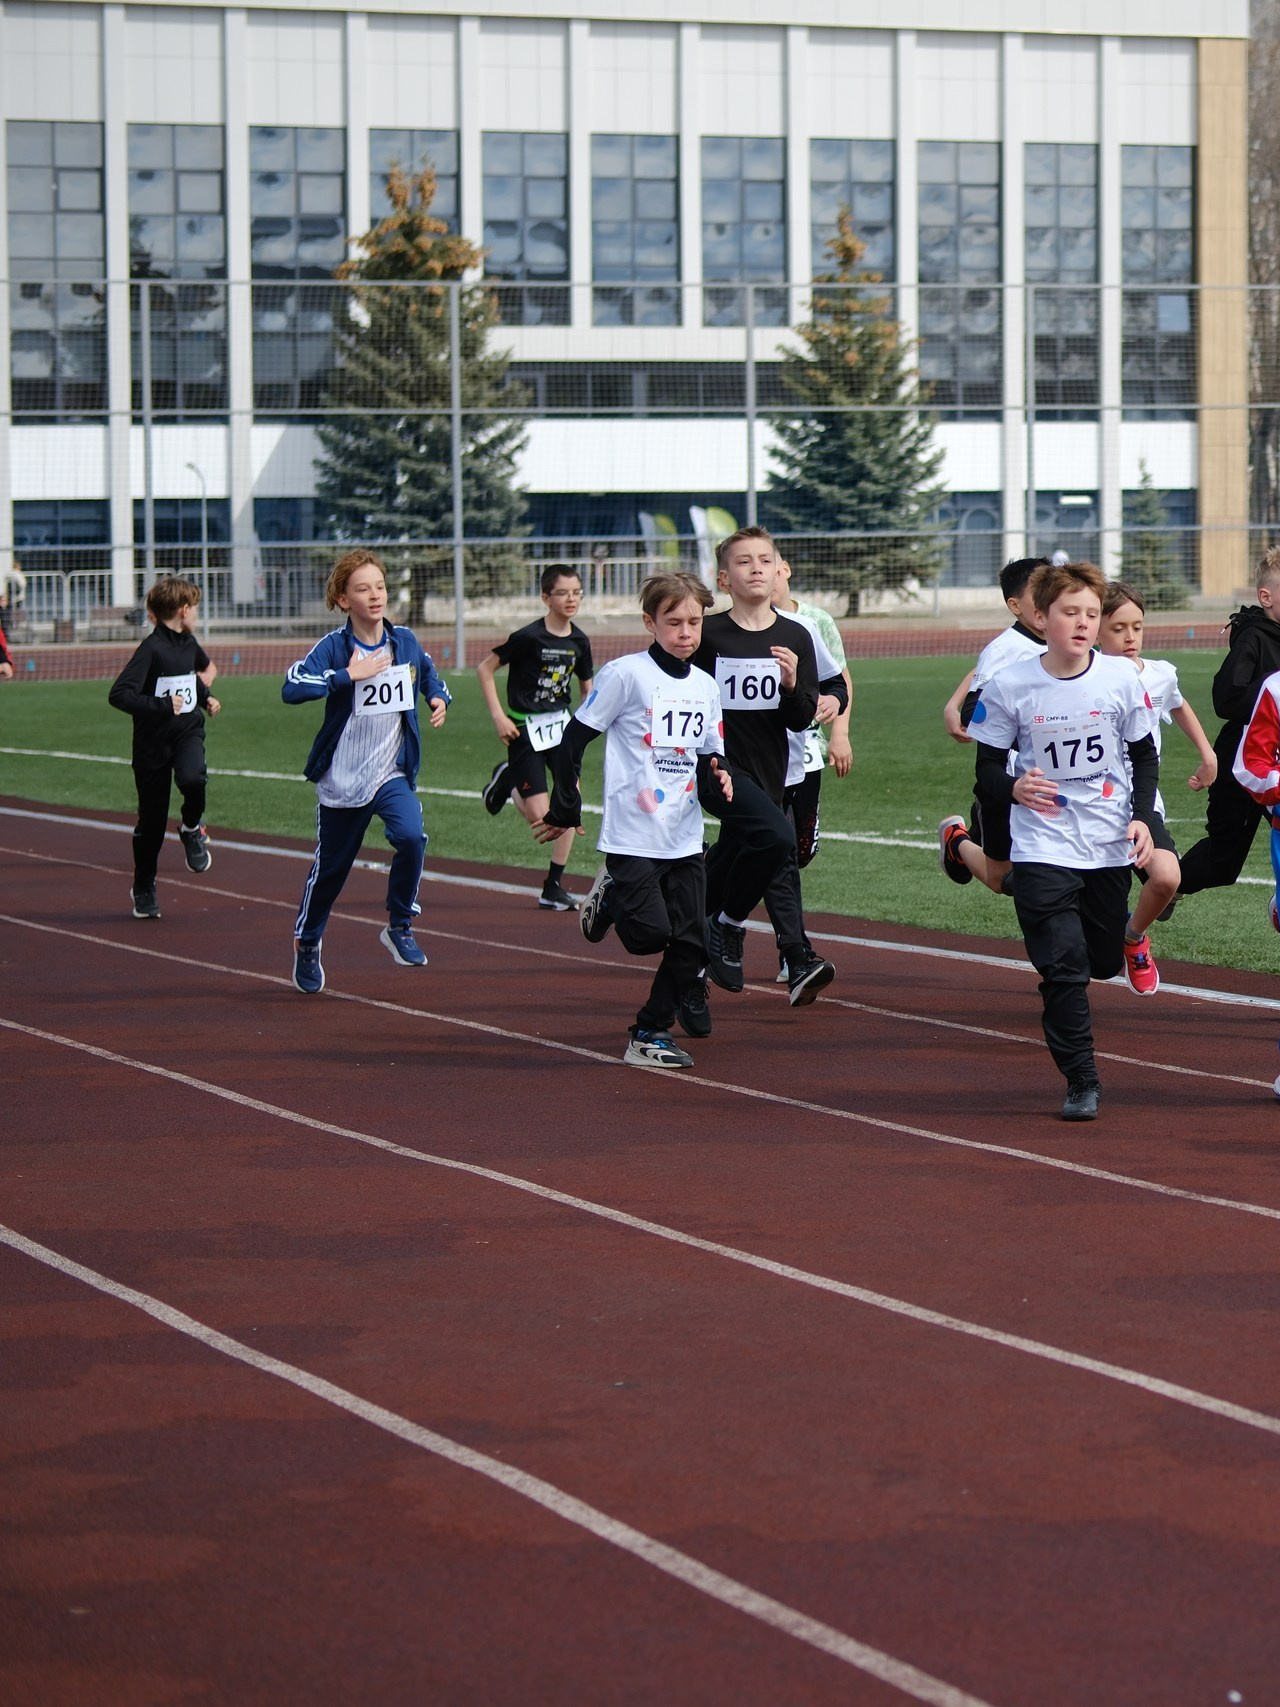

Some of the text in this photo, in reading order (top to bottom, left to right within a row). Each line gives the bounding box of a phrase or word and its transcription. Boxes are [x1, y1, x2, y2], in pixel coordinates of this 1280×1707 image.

[362, 680, 404, 707] 201
[724, 674, 777, 701] 160
[534, 720, 565, 743] 177
[661, 710, 704, 738] 173
[1043, 734, 1105, 769] 175
